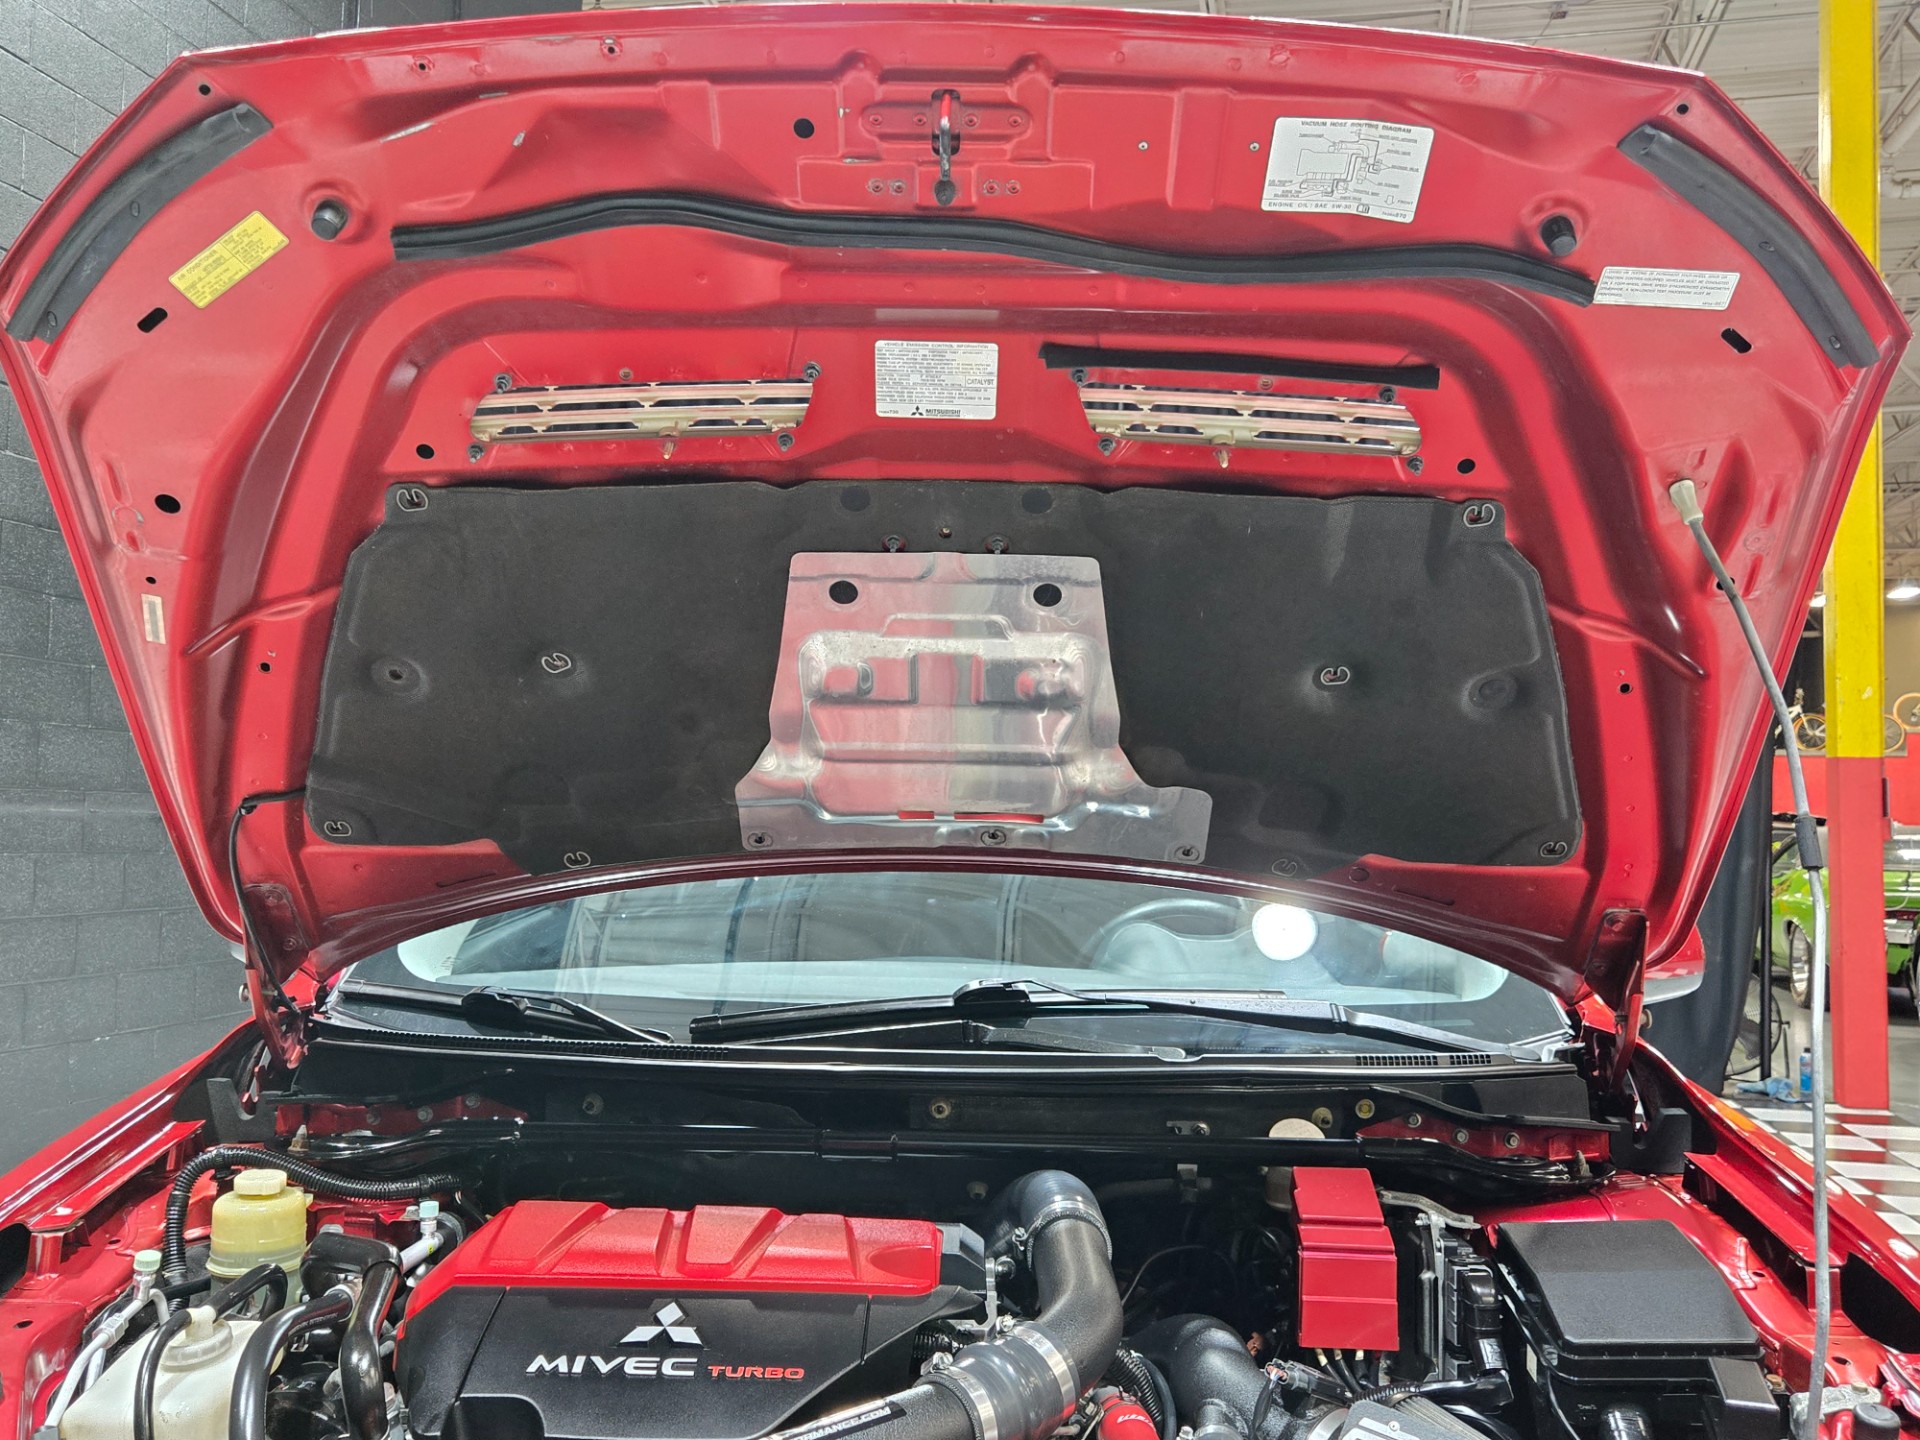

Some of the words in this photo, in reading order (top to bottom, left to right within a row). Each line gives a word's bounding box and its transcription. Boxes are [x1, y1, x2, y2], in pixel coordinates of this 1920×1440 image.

[1350, 122, 1379, 130] ROUTING
[1382, 125, 1412, 133] DIAGRAM
[966, 378, 995, 386] CATALYST
[525, 1354, 698, 1377] MIVEC
[707, 1365, 805, 1380] TURBO
